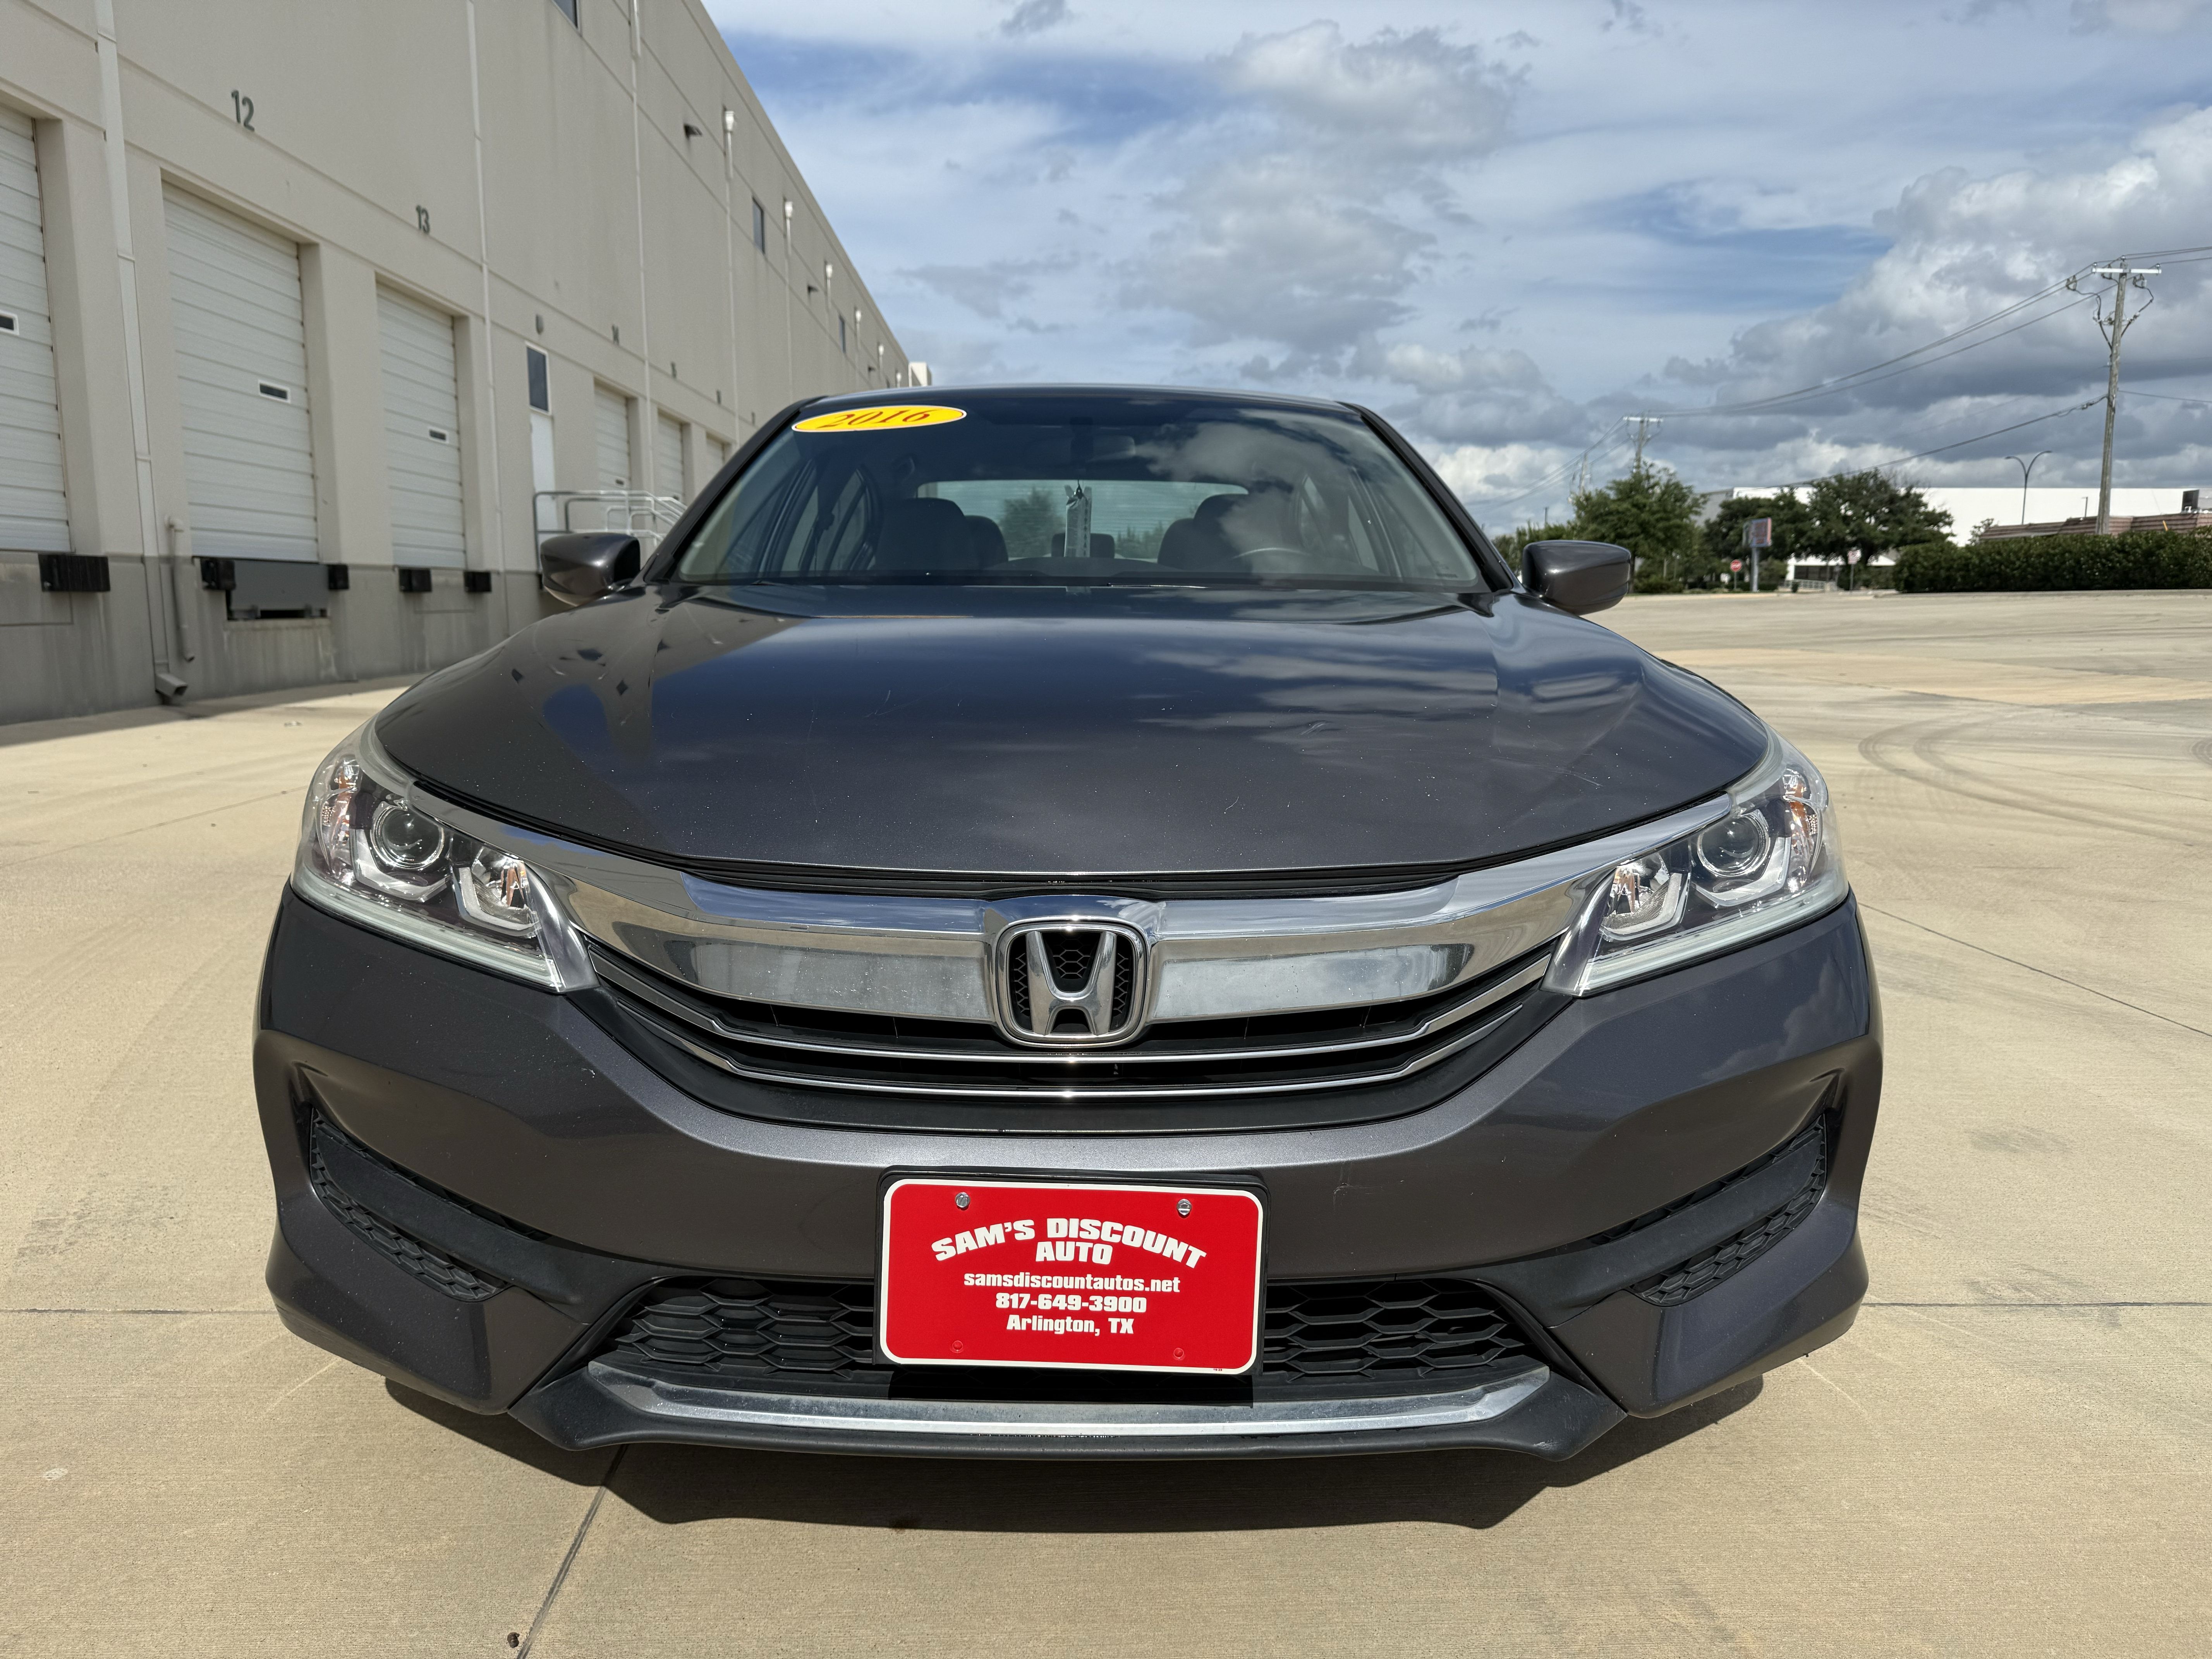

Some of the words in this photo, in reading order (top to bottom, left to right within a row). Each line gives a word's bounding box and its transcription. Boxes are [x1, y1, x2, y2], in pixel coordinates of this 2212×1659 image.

[231, 89, 255, 131] 12
[416, 204, 430, 235] 13
[816, 409, 940, 429] 2016
[931, 1219, 1035, 1261] SAM'S
[1047, 1218, 1207, 1269] DISCOUNT
[1035, 1240, 1113, 1265] AUTO
[963, 1271, 1181, 1293] samsdiscountautos.net
[995, 1292, 1147, 1313] 817-649-3900
[1006, 1314, 1101, 1337] Arlington,
[1108, 1317, 1135, 1334] TX
